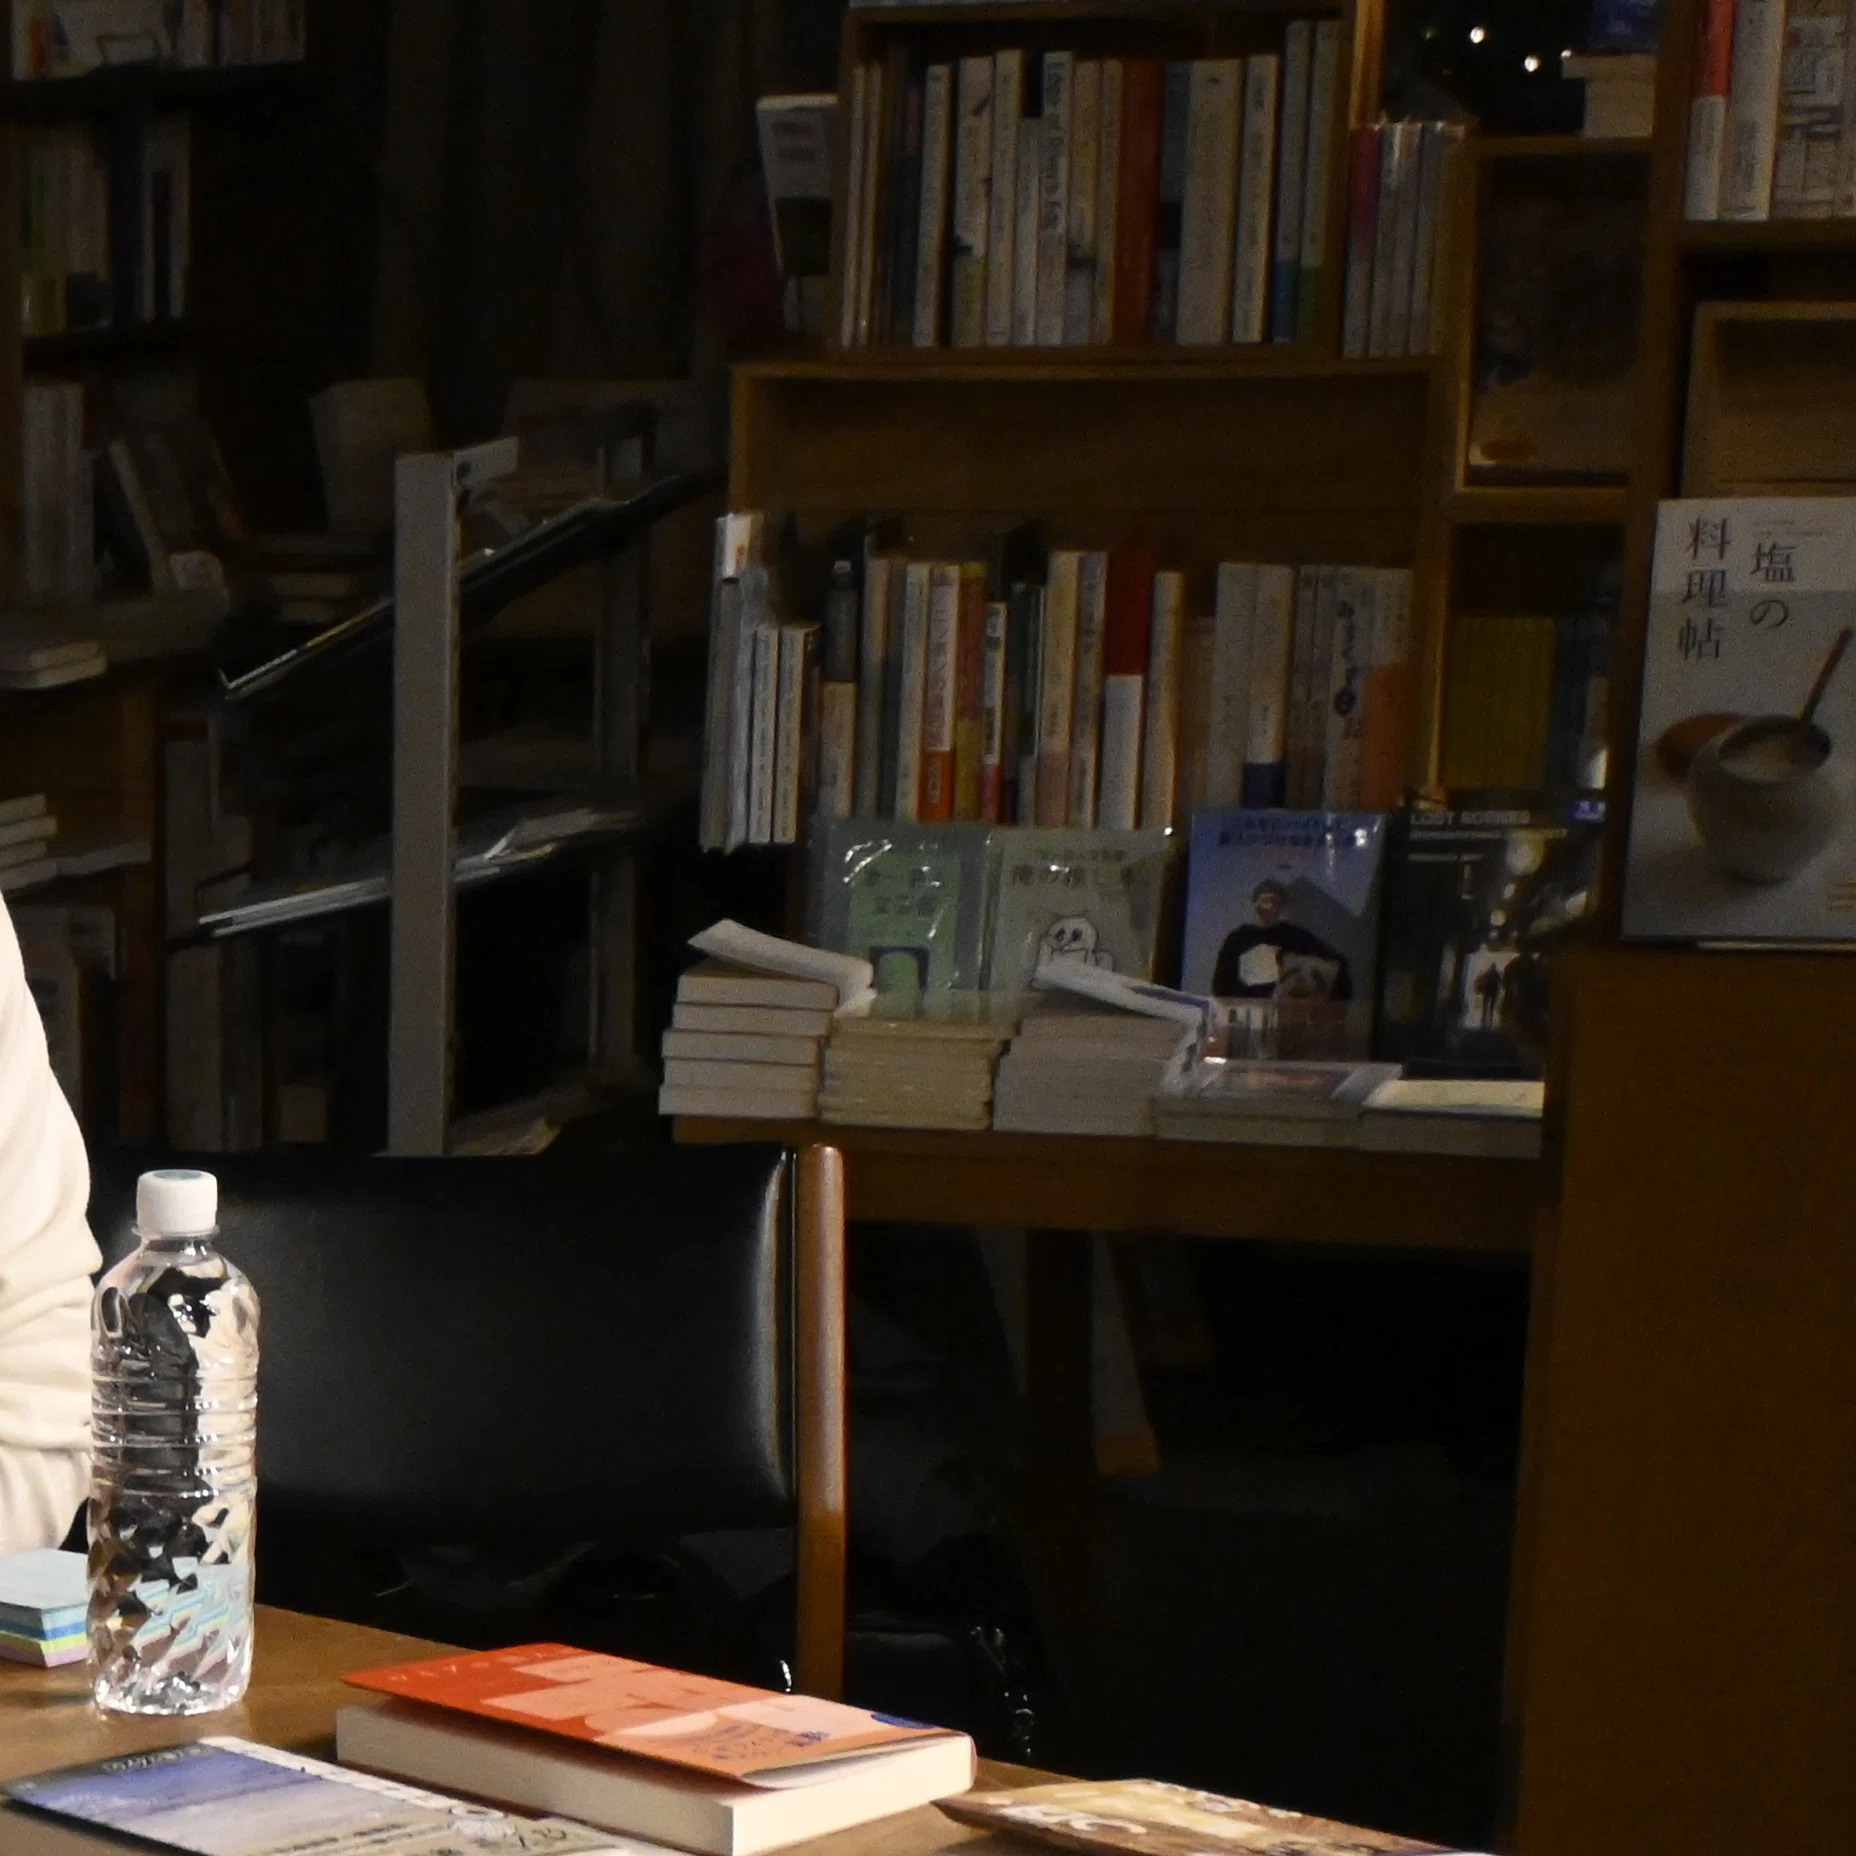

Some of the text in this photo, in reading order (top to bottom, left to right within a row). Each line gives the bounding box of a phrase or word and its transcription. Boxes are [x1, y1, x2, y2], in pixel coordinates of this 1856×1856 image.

[1678, 516, 1732, 661] 料理帖
[1750, 541, 1798, 630] 塩の
